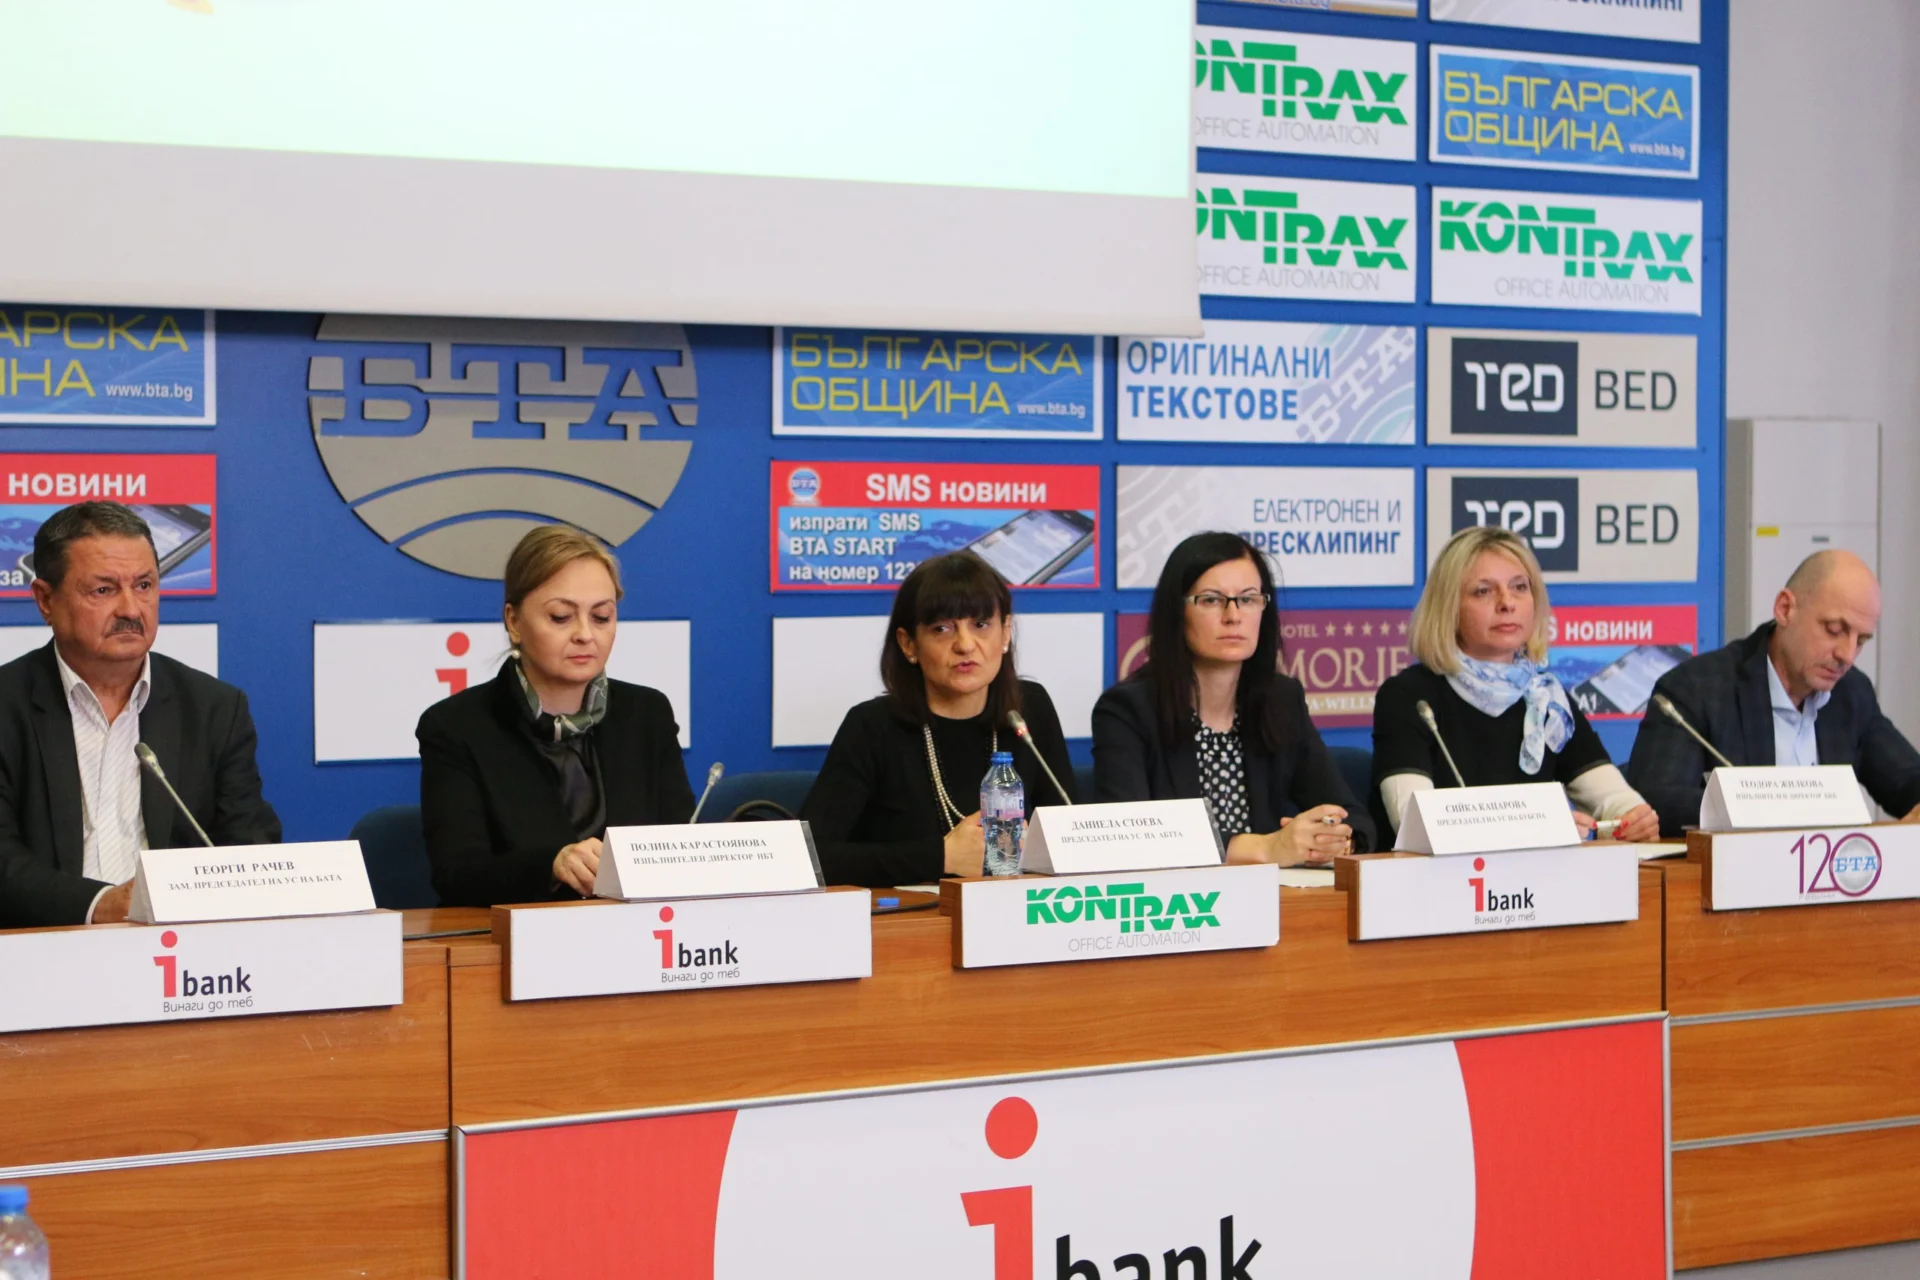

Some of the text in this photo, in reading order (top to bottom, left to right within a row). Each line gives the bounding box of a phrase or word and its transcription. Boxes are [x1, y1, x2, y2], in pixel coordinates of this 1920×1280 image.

[1444, 70, 1684, 121] БЪЛГАРСКА
[1256, 121, 1380, 146] AUTOMATION
[1444, 110, 1686, 160] ОБЩИНА www.bta.bg
[1440, 200, 1694, 284] KONTRAX
[1257, 267, 1380, 291] AUTOMATION
[1495, 277, 1669, 304] OFFICE AUTOMATION
[790, 333, 1084, 376] БЪЛГАРСКА
[1126, 340, 1331, 380] ОРИГИНАЛНИ
[0, 357, 193, 402] НА www.bta.bg
[309, 342, 694, 440] БТА
[1594, 369, 1678, 411] BED
[790, 375, 1087, 420] ОБЩИНА www.bta.bg
[1126, 385, 1298, 421] ТЕКСТОВЕ
[866, 473, 931, 503] SMS
[789, 512, 921, 534] изпрати SMS
[1254, 498, 1401, 523] ЕЛЕКТРОНЕН И
[1595, 503, 1679, 545] BED
[789, 536, 897, 556] BTA START
[789, 561, 922, 584] на номер 123
[1275, 645, 1410, 689] MORIE
[1445, 800, 1527, 813] СИЙКА КАЦАРОВА
[1071, 817, 1164, 831] ДАНИЕЛА СТОЕВА
[1436, 816, 1485, 827] ПРЕДСЕДАТЕЛ
[630, 838, 768, 852] ПОЛИНА КАРАСТОЯНОВА
[1061, 833, 1117, 844] ПРЕДСЕДАТЕЛ
[1118, 832, 1130, 841] НА
[1130, 832, 1141, 841] УС
[1144, 831, 1156, 840] НА
[193, 860, 295, 876] ГЕОРГИ РАЧЕВ
[633, 852, 775, 865] ИЗПЪЛНИТЕЛЕН ДИРЕКТОР НБТ
[1789, 831, 1883, 898] 120
[1834, 855, 1878, 873] БТА
[167, 873, 343, 892] ЗАМ. ПРЕДСЕДАТЕЛ НА УС НА БАТА
[1026, 882, 1221, 933] KONTRAX
[1474, 911, 1536, 926] Винаги до теб
[1068, 930, 1201, 953] OFFICE AUTOMATION
[661, 966, 740, 984] Винаги до теб
[163, 995, 254, 1013] Винаги до теб
